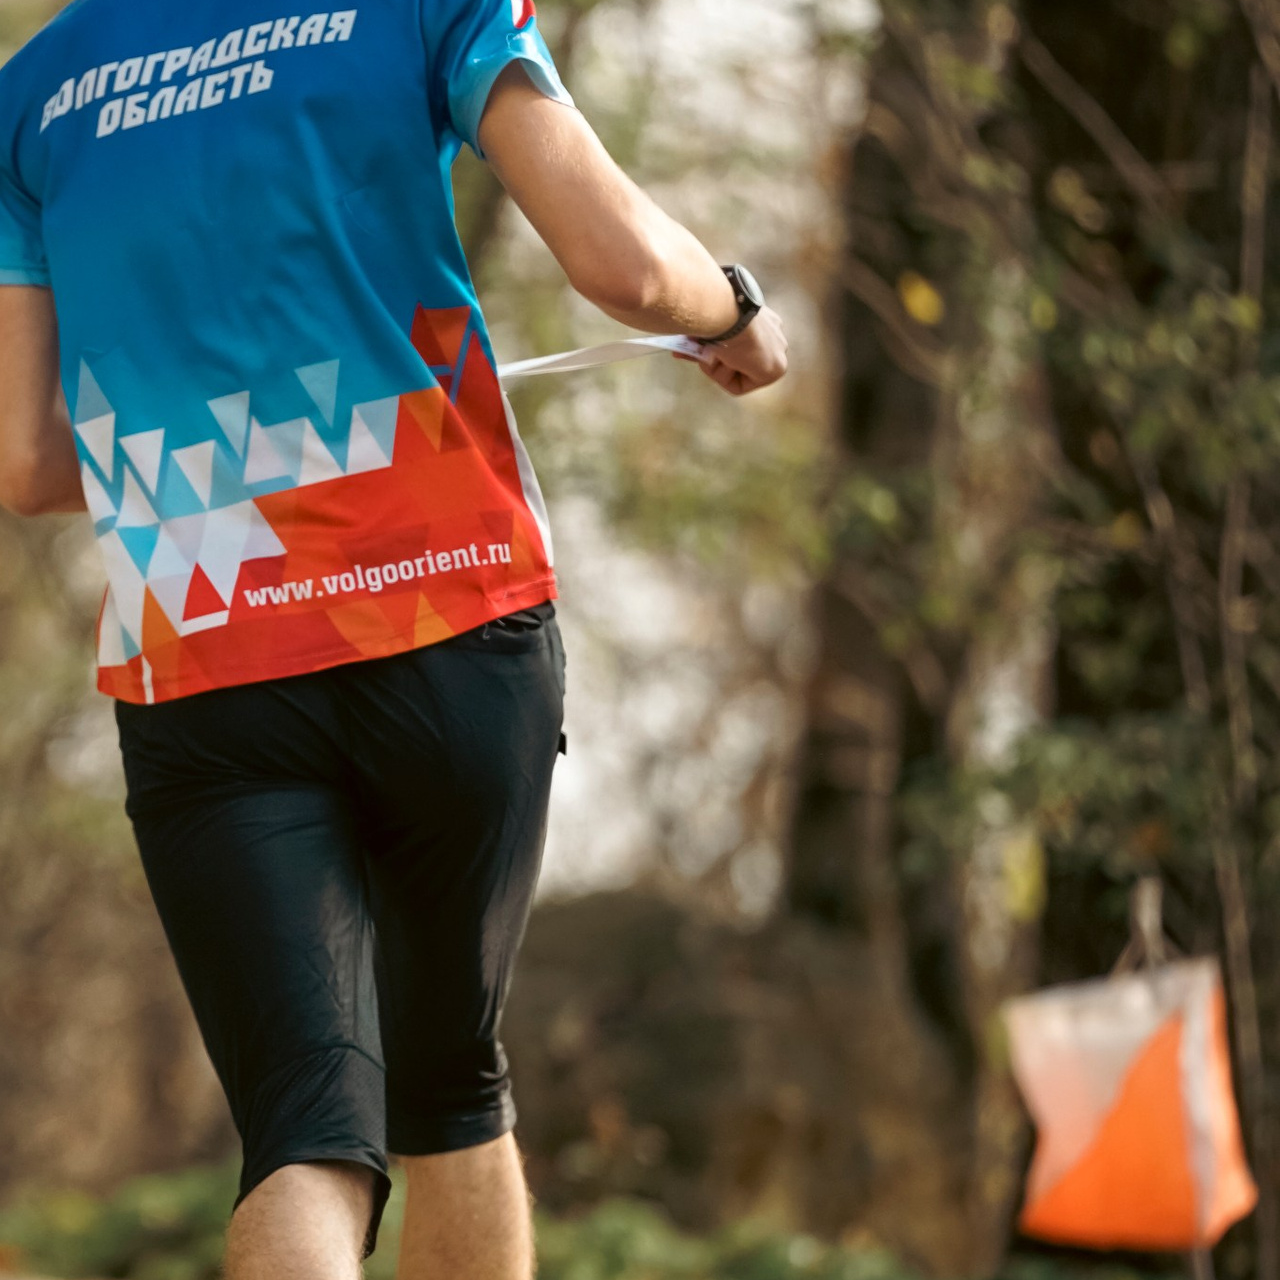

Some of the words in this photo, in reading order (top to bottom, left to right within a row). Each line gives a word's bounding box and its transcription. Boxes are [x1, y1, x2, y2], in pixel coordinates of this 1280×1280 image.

[39, 9, 357, 134] ВОЛГОГРАДСКАЯ
[96, 60, 275, 138] ОБЛАСТЬ
[244, 542, 512, 607] www.volgoorient.ru
